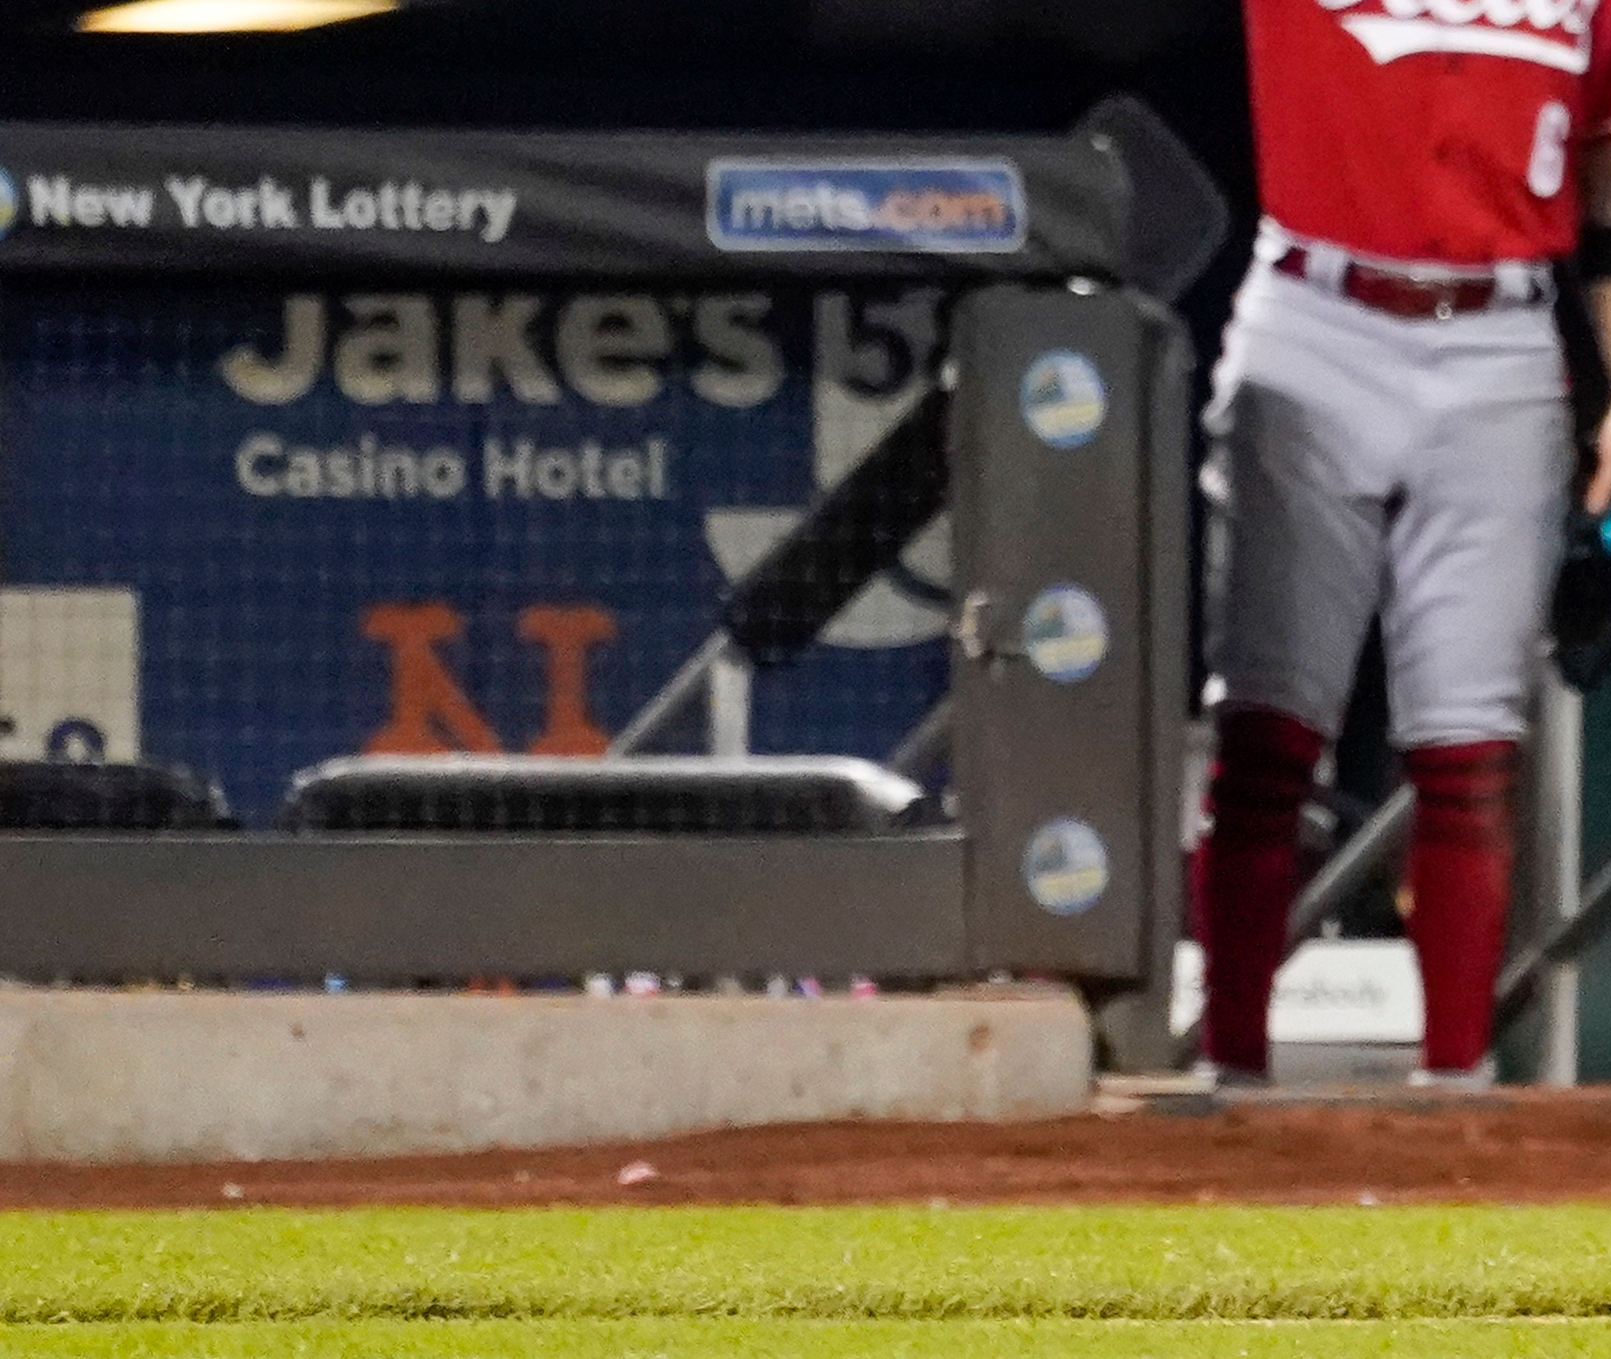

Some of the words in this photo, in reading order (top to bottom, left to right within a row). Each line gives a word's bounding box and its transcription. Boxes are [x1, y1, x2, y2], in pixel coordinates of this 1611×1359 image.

[1527, 101, 1571, 198] 6
[27, 175, 154, 228] New
[164, 175, 296, 229] York
[310, 176, 517, 242] Lottery
[731, 181, 1004, 231] mets.com
[234, 433, 467, 498] Casino
[483, 438, 668, 499] Hotel
